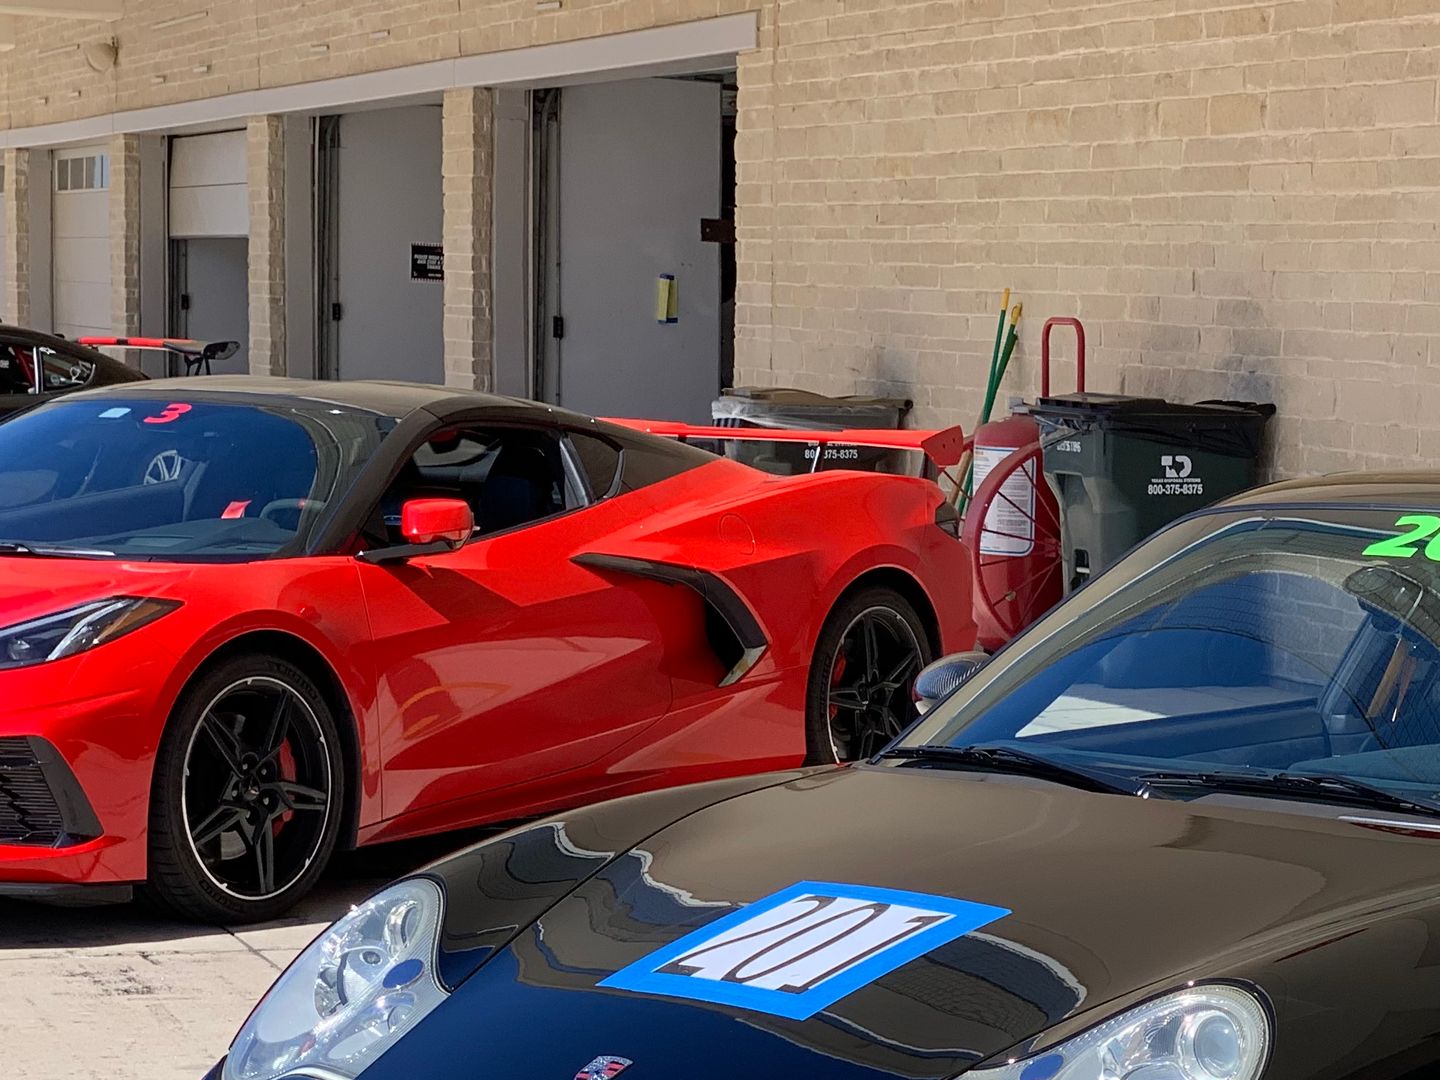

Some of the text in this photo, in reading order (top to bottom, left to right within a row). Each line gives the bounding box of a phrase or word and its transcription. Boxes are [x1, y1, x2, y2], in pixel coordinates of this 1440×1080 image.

[143, 403, 193, 424] 3
[1148, 484, 1203, 495] 800-375-8375
[654, 895, 951, 994] 201
